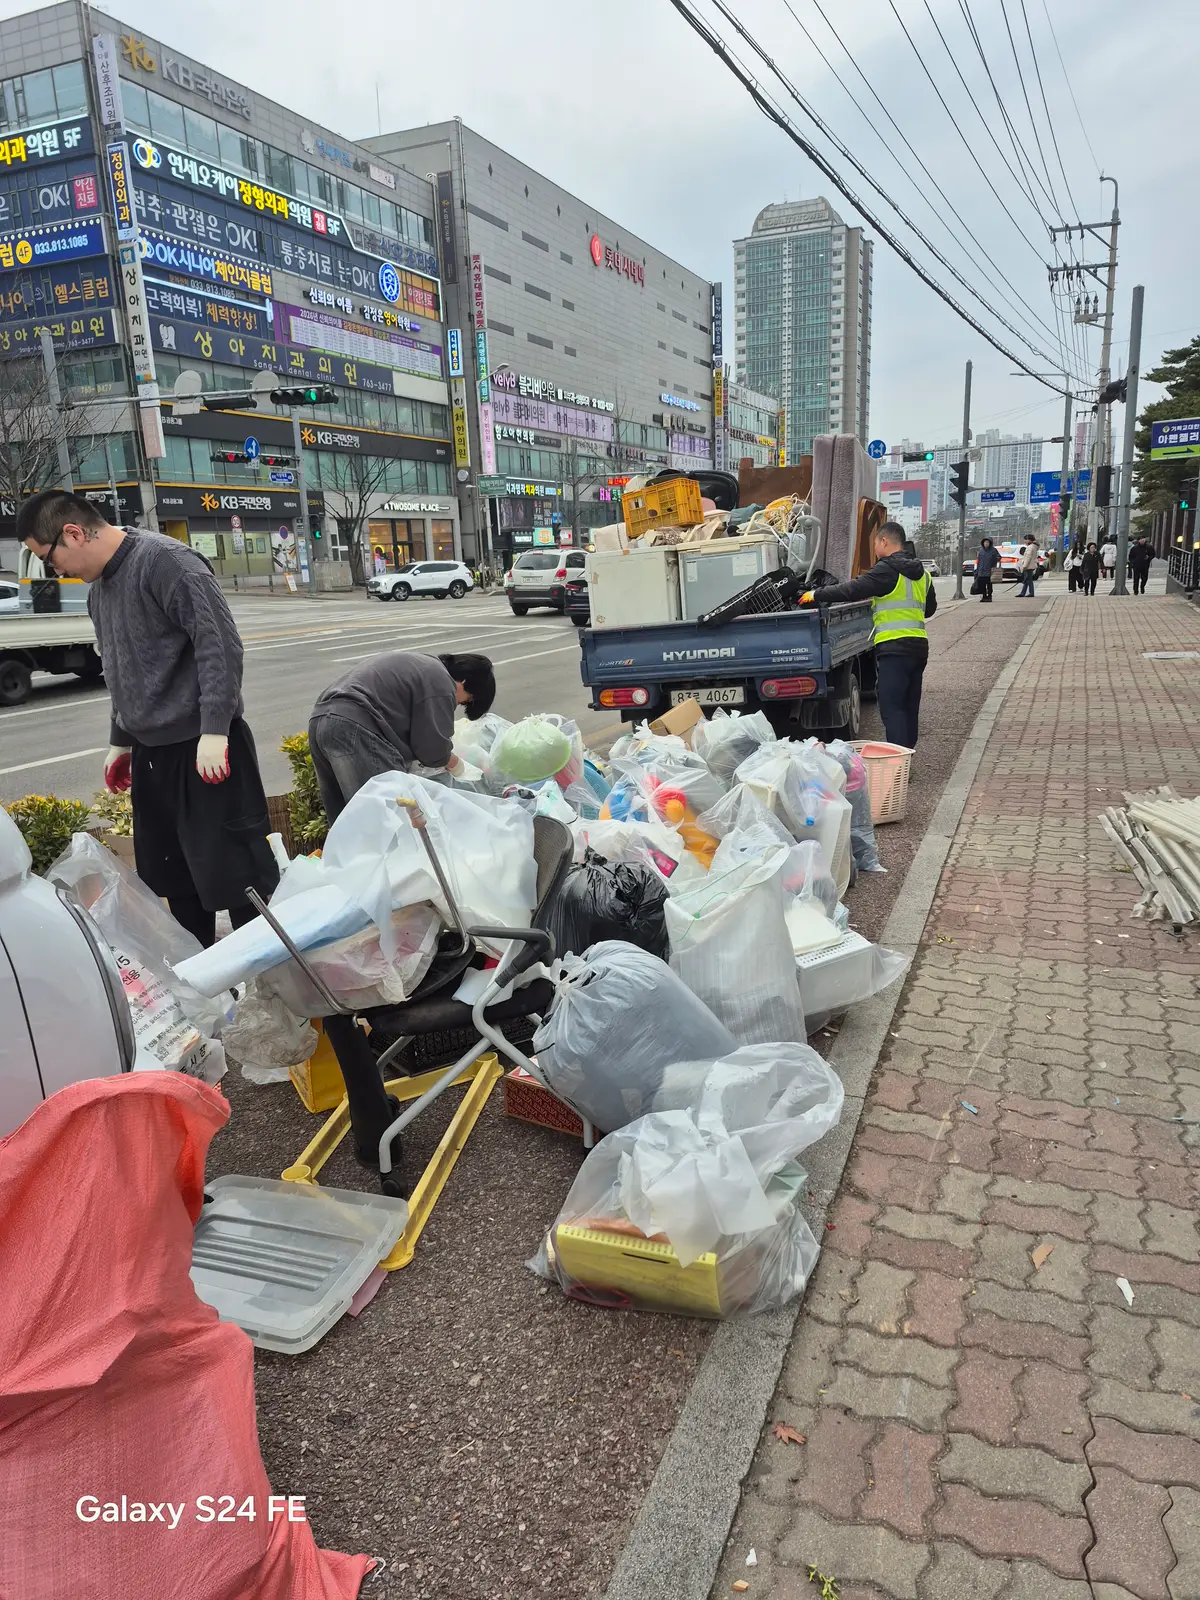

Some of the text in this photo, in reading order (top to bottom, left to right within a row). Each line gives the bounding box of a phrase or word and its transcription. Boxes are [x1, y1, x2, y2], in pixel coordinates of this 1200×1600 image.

[100, 61, 117, 122] 산후조리원
[160, 54, 253, 121] KB국민은행
[63, 127, 82, 149] 5F
[39, 184, 70, 210] OK!
[77, 190, 96, 207] 진료
[111, 153, 130, 222] 정형외과
[167, 152, 313, 229] 연세오케이정형외과의원
[226, 222, 258, 253] OK!
[327, 217, 341, 236] 5F
[19, 246, 29, 257] 4F
[34, 234, 88, 255] 033.813.1085
[54, 276, 110, 304] 헬스클럽
[190, 279, 236, 299] 033.813.1085
[352, 267, 376, 293] OK!
[146, 287, 258, 331] 근력회복! 체력향상!
[309, 286, 336, 309] 신뢰의
[336, 296, 353, 314] 이름
[362, 304, 412, 332] 김정은영어학원
[194, 330, 357, 386] 상아치과의원
[253, 358, 392, 392] Sang-A dental clinic 763-3477
[493, 372, 516, 391] velyB
[317, 431, 360, 449] KB국민은행
[1158, 431, 1199, 444] 아펜젤러
[220, 495, 272, 511] KB국민은행
[389, 502, 420, 511] TWOSOME
[420, 503, 439, 512] PLACE
[663, 647, 736, 661] HYUNDAI
[706, 689, 737, 702] 4067
